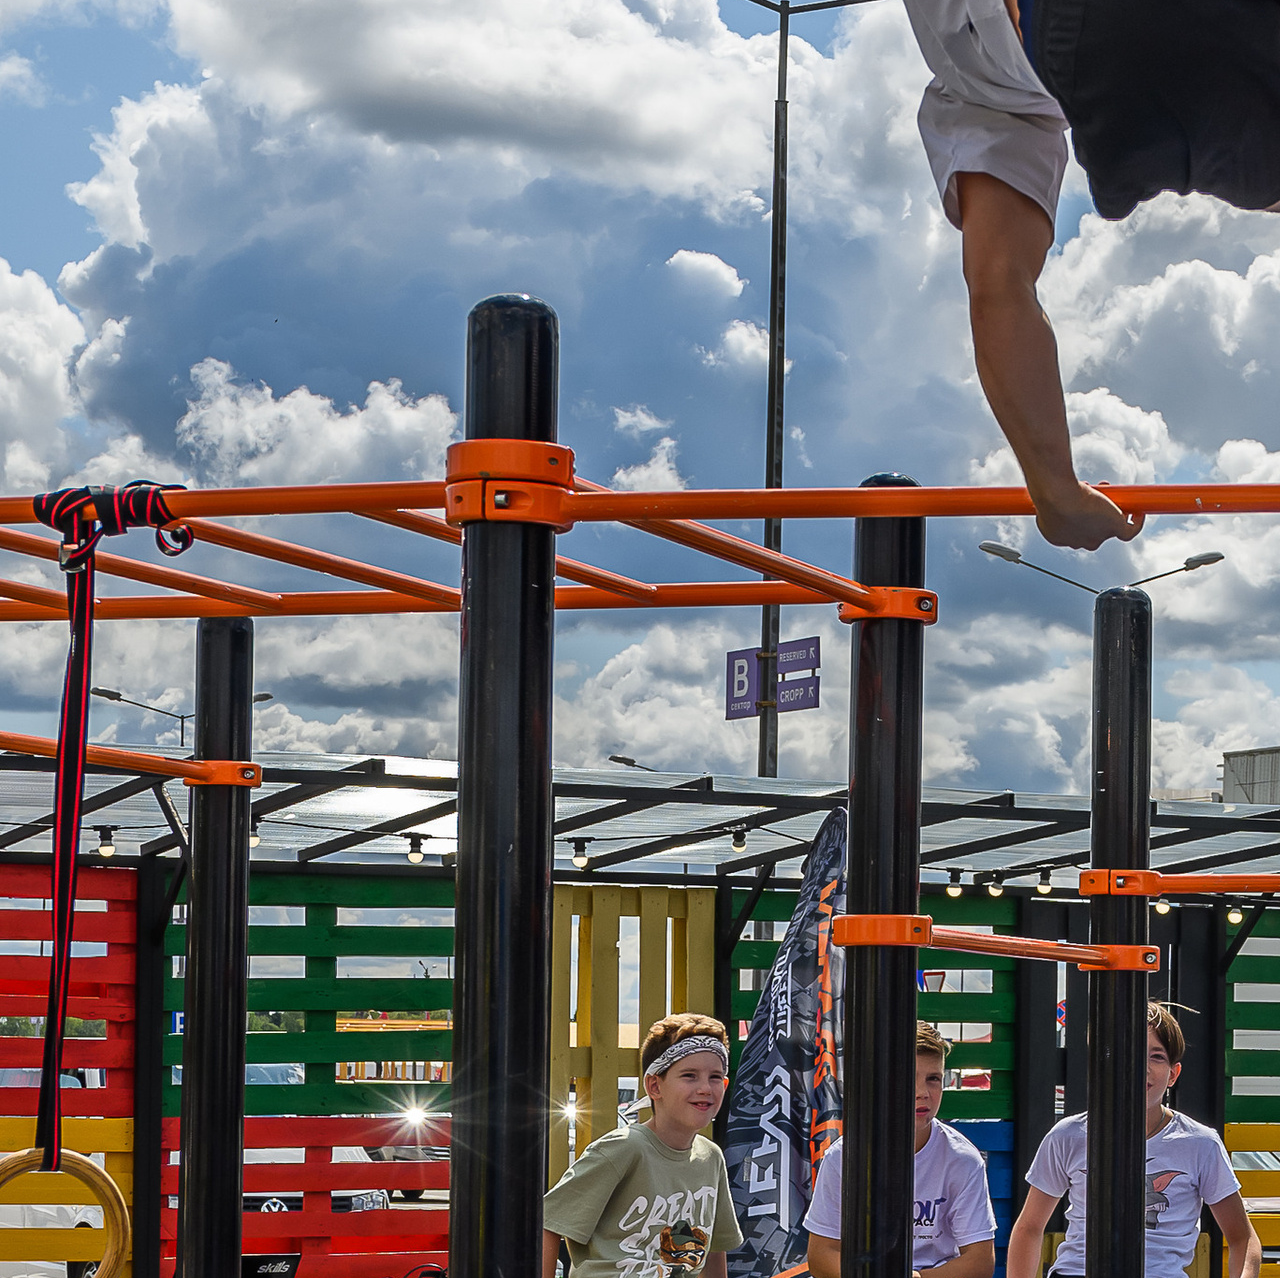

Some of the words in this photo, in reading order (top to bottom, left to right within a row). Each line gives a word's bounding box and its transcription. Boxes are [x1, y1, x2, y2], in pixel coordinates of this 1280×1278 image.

[779, 649, 807, 662] RESERVED
[780, 687, 804, 703] CROPP
[256, 1261, 290, 1273] skills
